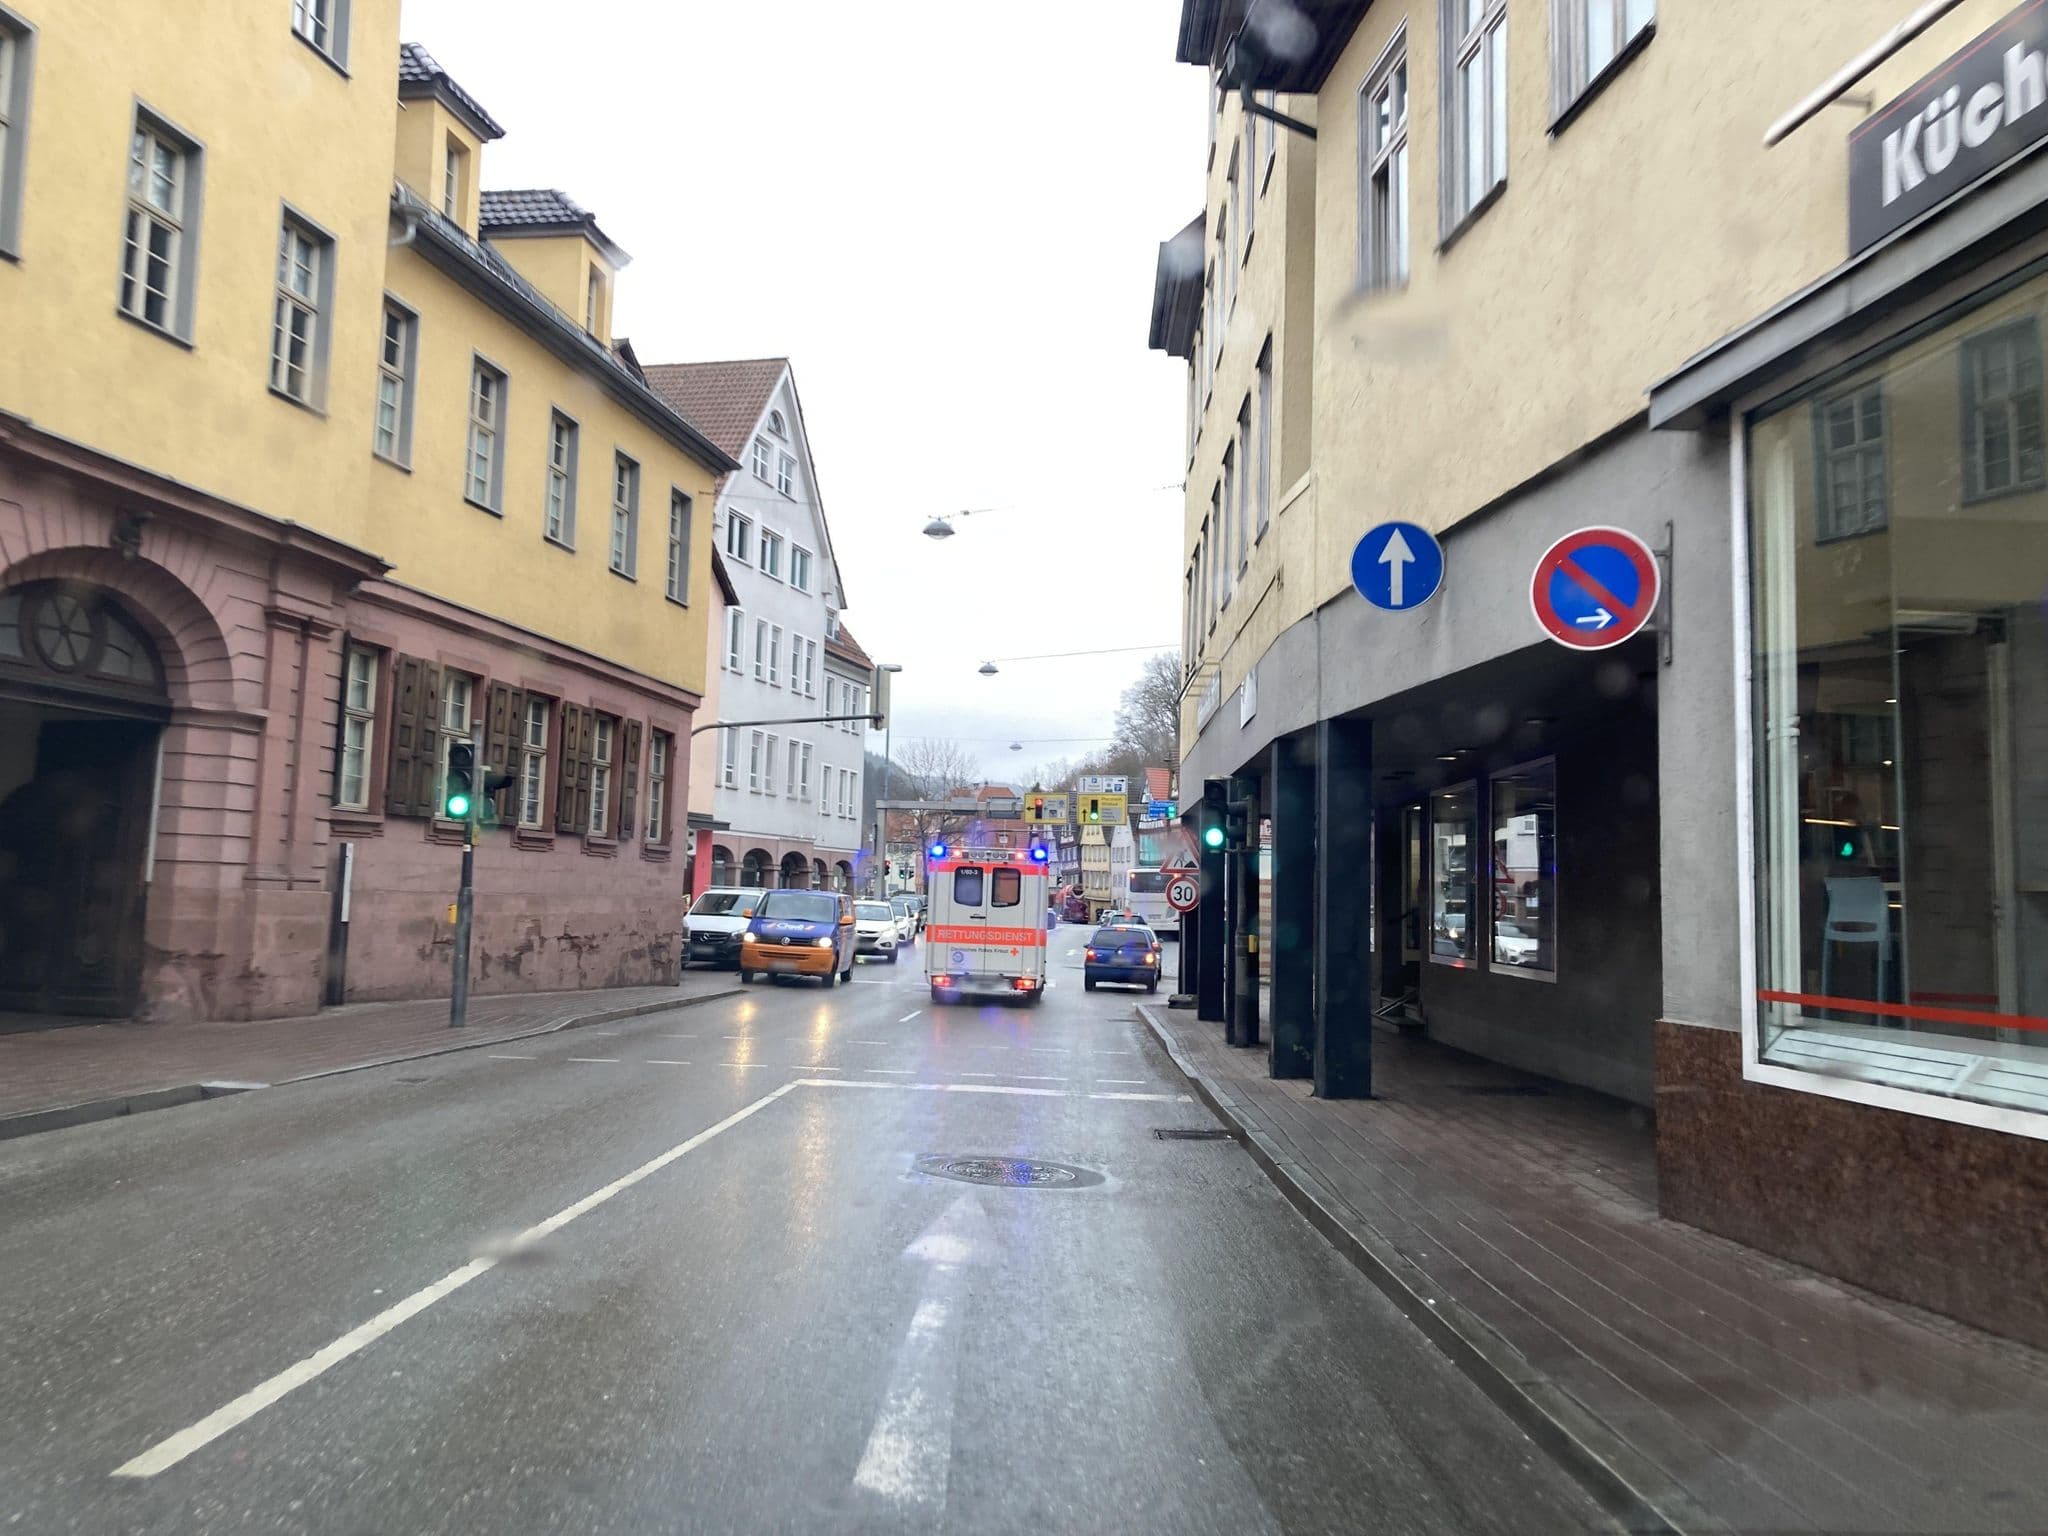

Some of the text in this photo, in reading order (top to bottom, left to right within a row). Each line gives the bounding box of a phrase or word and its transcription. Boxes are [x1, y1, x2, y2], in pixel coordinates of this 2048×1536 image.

[1882, 39, 2048, 208] Küch
[1174, 885, 1193, 902] 30
[938, 929, 1032, 942] RETTUNGSDIENST
